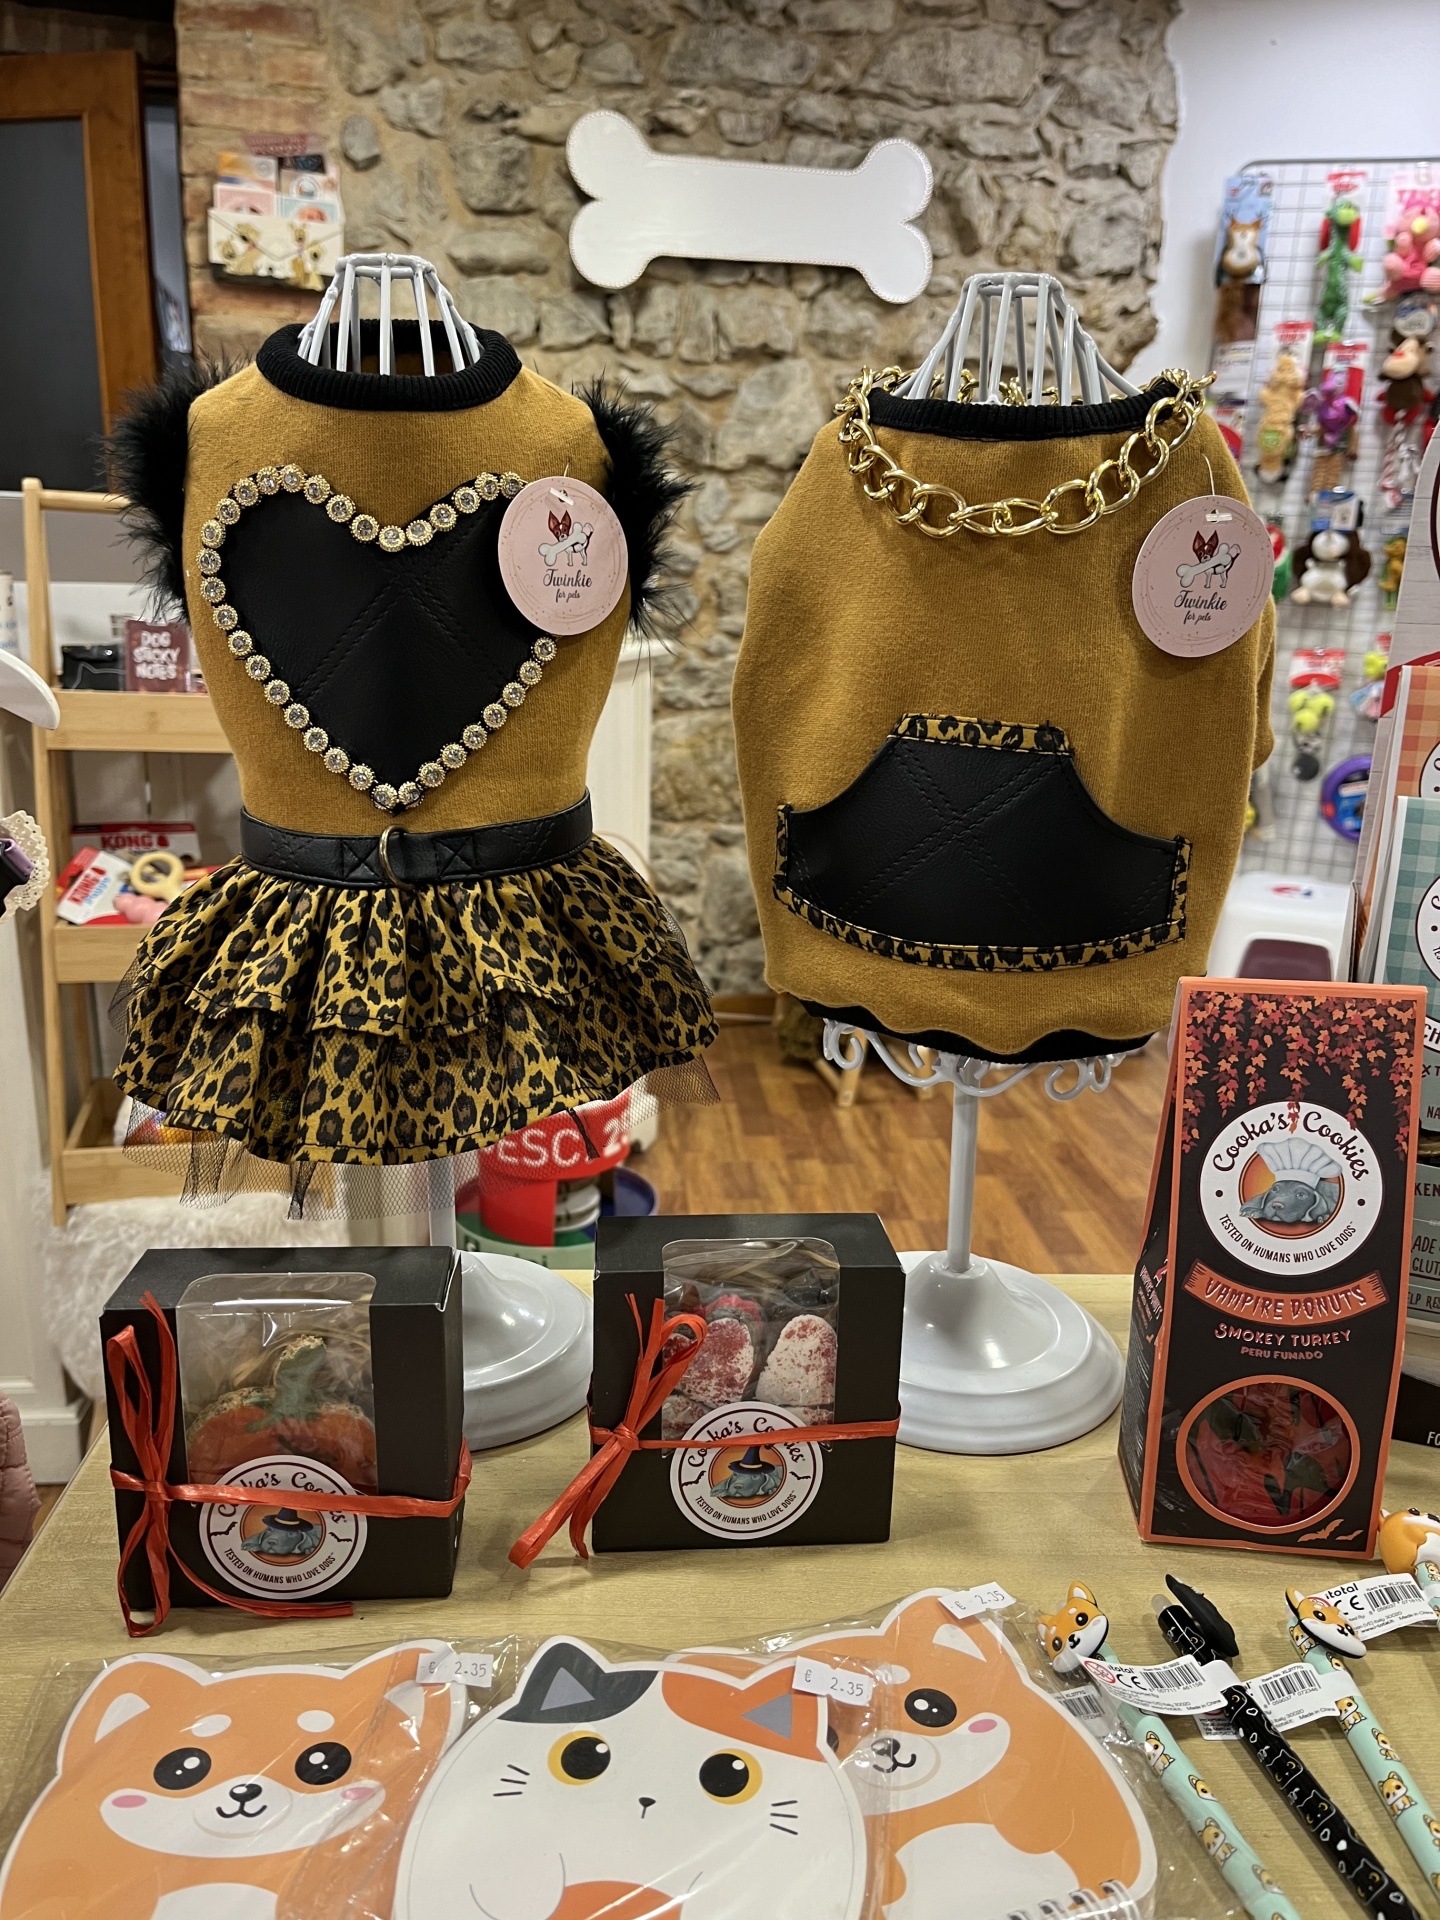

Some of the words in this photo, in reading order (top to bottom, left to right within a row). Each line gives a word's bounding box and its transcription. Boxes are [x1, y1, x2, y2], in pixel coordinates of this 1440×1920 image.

[542, 568, 593, 588] Twinkie
[555, 589, 566, 603] for
[566, 590, 581, 603] pets
[1173, 589, 1228, 610] Twinkie
[1183, 610, 1195, 625] for
[1194, 612, 1212, 625] pets
[141, 631, 171, 648] DOG
[101, 835, 153, 849] KONG
[1213, 1112, 1290, 1172] Cooka's
[1302, 1111, 1369, 1182] Cookies
[1218, 1213, 1242, 1243] TESTED
[1240, 1238, 1254, 1252] ON
[1253, 1245, 1291, 1263] HUMANS
[1292, 1247, 1315, 1263] WHO
[1314, 1240, 1338, 1260] LOVE
[1204, 1277, 1285, 1320] VAMPIRE
[1289, 1285, 1367, 1321] DONUTS
[1214, 1322, 1285, 1346] SMOKEY
[1290, 1329, 1351, 1347] TURKEY
[1240, 1346, 1271, 1359] PERU
[1272, 1350, 1324, 1360] FUMADO
[695, 1495, 714, 1515] TESTED
[712, 1511, 723, 1520] ON
[721, 1514, 750, 1525] HUMANS
[751, 1514, 767, 1525] WHO
[766, 1507, 784, 1519] LOVE
[224, 1547, 243, 1569] TESTED
[242, 1564, 253, 1576] ON
[252, 1569, 284, 1584] HUMANS
[285, 1574, 303, 1584] WHO
[302, 1568, 322, 1580] LOVE
[974, 1590, 1005, 1605] 2.35
[1325, 1582, 1358, 1600] itotal
[454, 1661, 487, 1677] 2.35
[804, 1669, 812, 1683] €
[830, 1676, 864, 1697] 2.35
